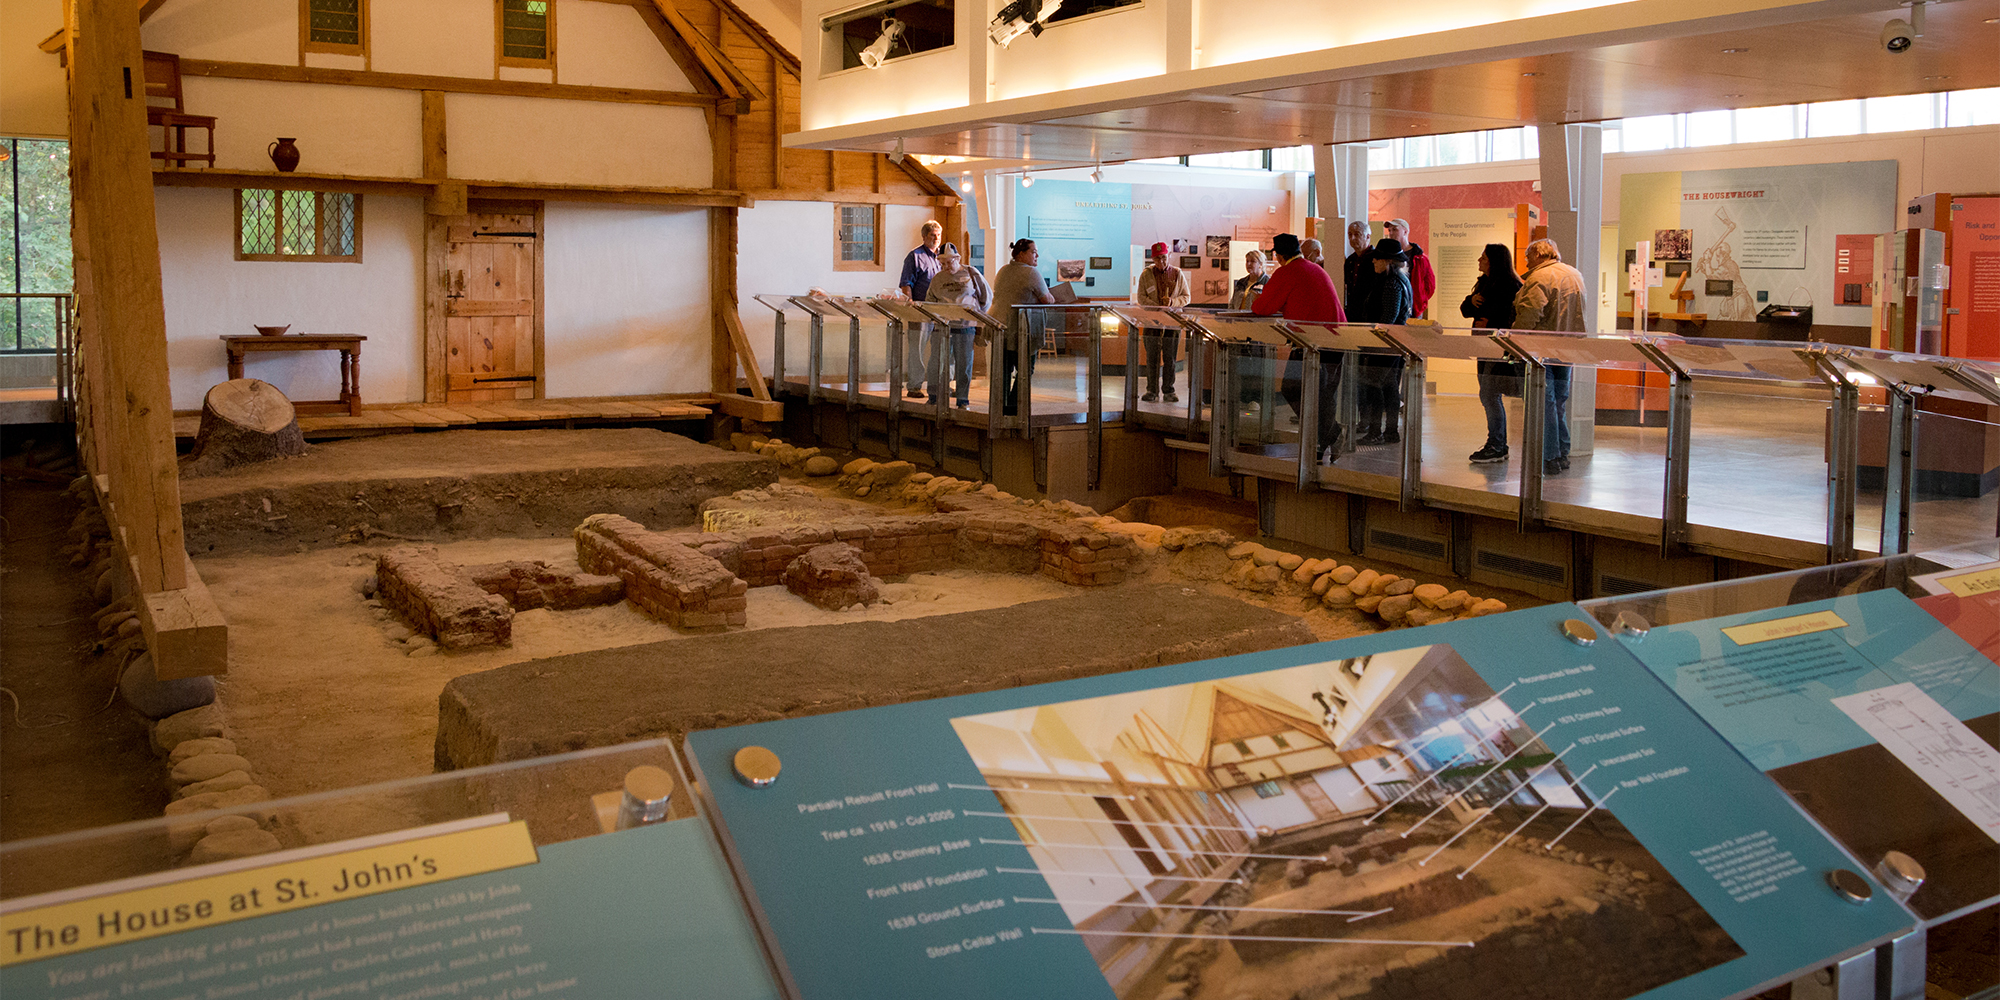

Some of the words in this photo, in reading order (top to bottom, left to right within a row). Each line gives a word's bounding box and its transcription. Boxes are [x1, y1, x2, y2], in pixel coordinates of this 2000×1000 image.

[1702, 190, 1765, 200] HOUSEWRIGHT
[1965, 221, 1980, 229] Risk
[798, 799, 844, 814] Partially
[844, 791, 884, 808] Rebuilt
[884, 786, 917, 801] Front
[915, 782, 940, 795] Wall
[821, 829, 848, 842] Tree
[905, 815, 926, 827] Cut
[892, 844, 942, 862] Chimney
[942, 838, 972, 852] Base
[866, 886, 899, 899] Front
[899, 879, 925, 893] Wall
[925, 867, 988, 888] Foundation
[7, 924, 80, 956] The
[97, 898, 214, 938] House
[229, 887, 263, 914] at
[275, 877, 319, 903] St.
[332, 854, 439, 893] John's
[917, 907, 961, 925] Ground
[961, 898, 1005, 914] Surface
[48, 968, 87, 988] You
[92, 960, 127, 979] are
[131, 944, 207, 971] looking
[230, 935, 256, 950] the
[259, 928, 299, 944] ruins
[332, 911, 376, 930] house
[378, 903, 414, 920] built
[468, 889, 486, 904] by
[488, 882, 522, 901] John
[138, 970, 184, 991] stood
[187, 961, 227, 982] until
[291, 942, 320, 960] and
[323, 936, 351, 952] had
[355, 930, 394, 948] many
[397, 915, 461, 938] different
[462, 901, 533, 923] occupants
[926, 943, 962, 959] Stone
[961, 934, 996, 951] Cellar
[996, 927, 1024, 941] Wall
[331, 951, 390, 973] Charles
[451, 931, 477, 949] and
